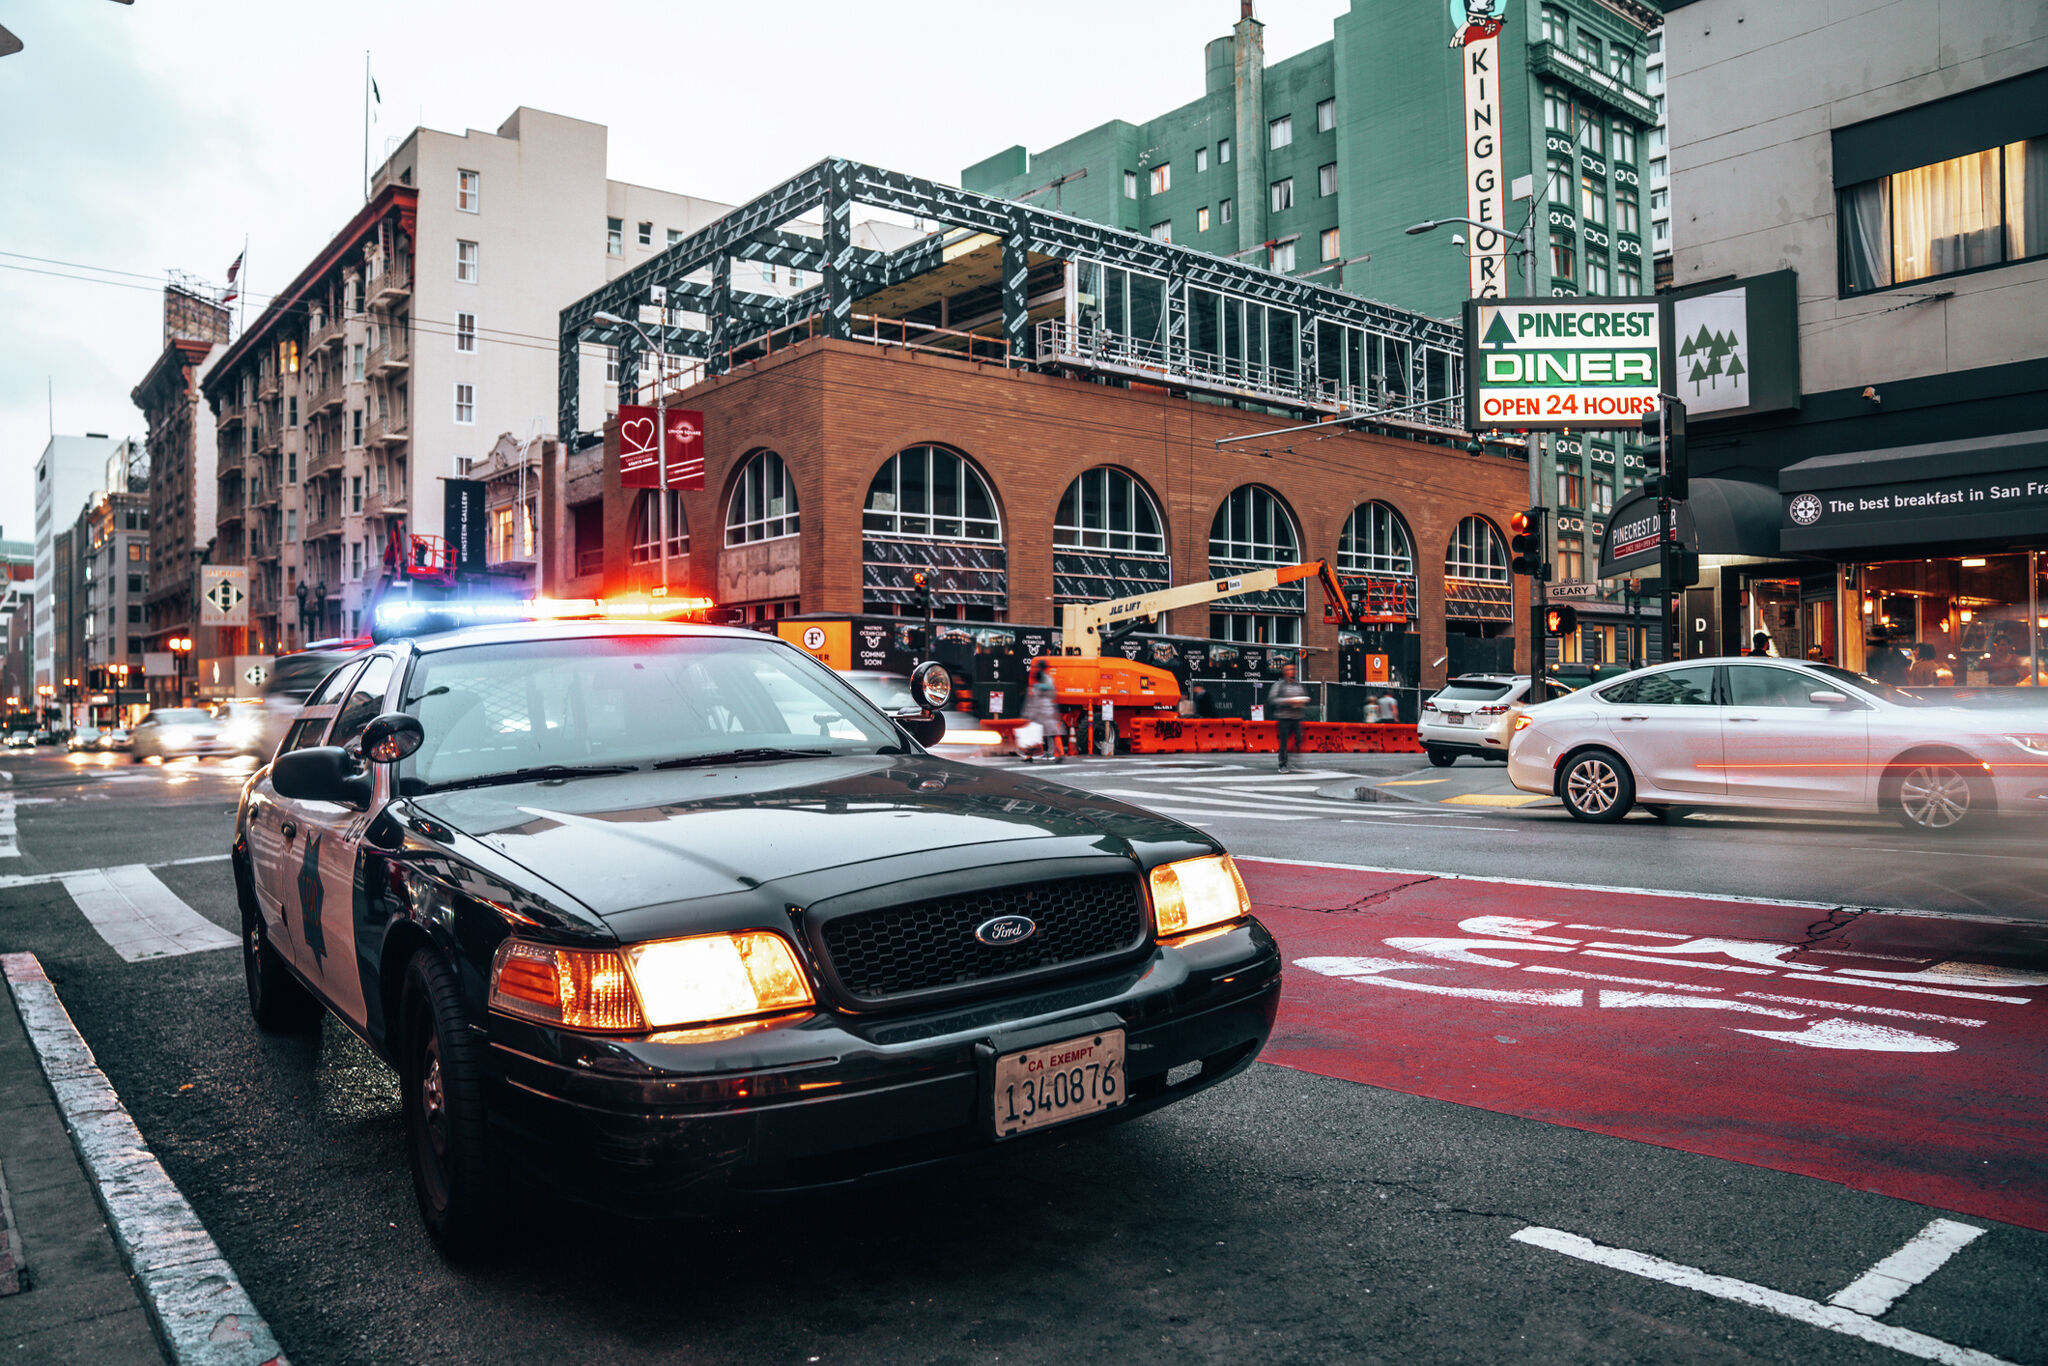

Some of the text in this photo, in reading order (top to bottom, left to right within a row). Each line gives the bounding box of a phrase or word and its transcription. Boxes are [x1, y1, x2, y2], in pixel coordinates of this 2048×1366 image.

[1472, 47, 1493, 159] KING
[1518, 312, 1655, 337] PINECREST
[1486, 353, 1653, 383] DINER
[1484, 394, 1655, 416] OPEN 24 HOURS
[1829, 501, 1855, 513] The
[1859, 496, 1890, 511] best
[1894, 490, 1964, 507] breakfast
[1969, 488, 1984, 501] in
[1990, 485, 2020, 500] San
[1613, 508, 1677, 545] PINECREST DIR
[1552, 586, 1588, 596] GEARY
[1109, 601, 1141, 616] JLG LIFT
[992, 921, 1023, 940] Ford
[1028, 1046, 1094, 1072] CA EXEMPT
[1005, 1059, 1116, 1121] 1340876
